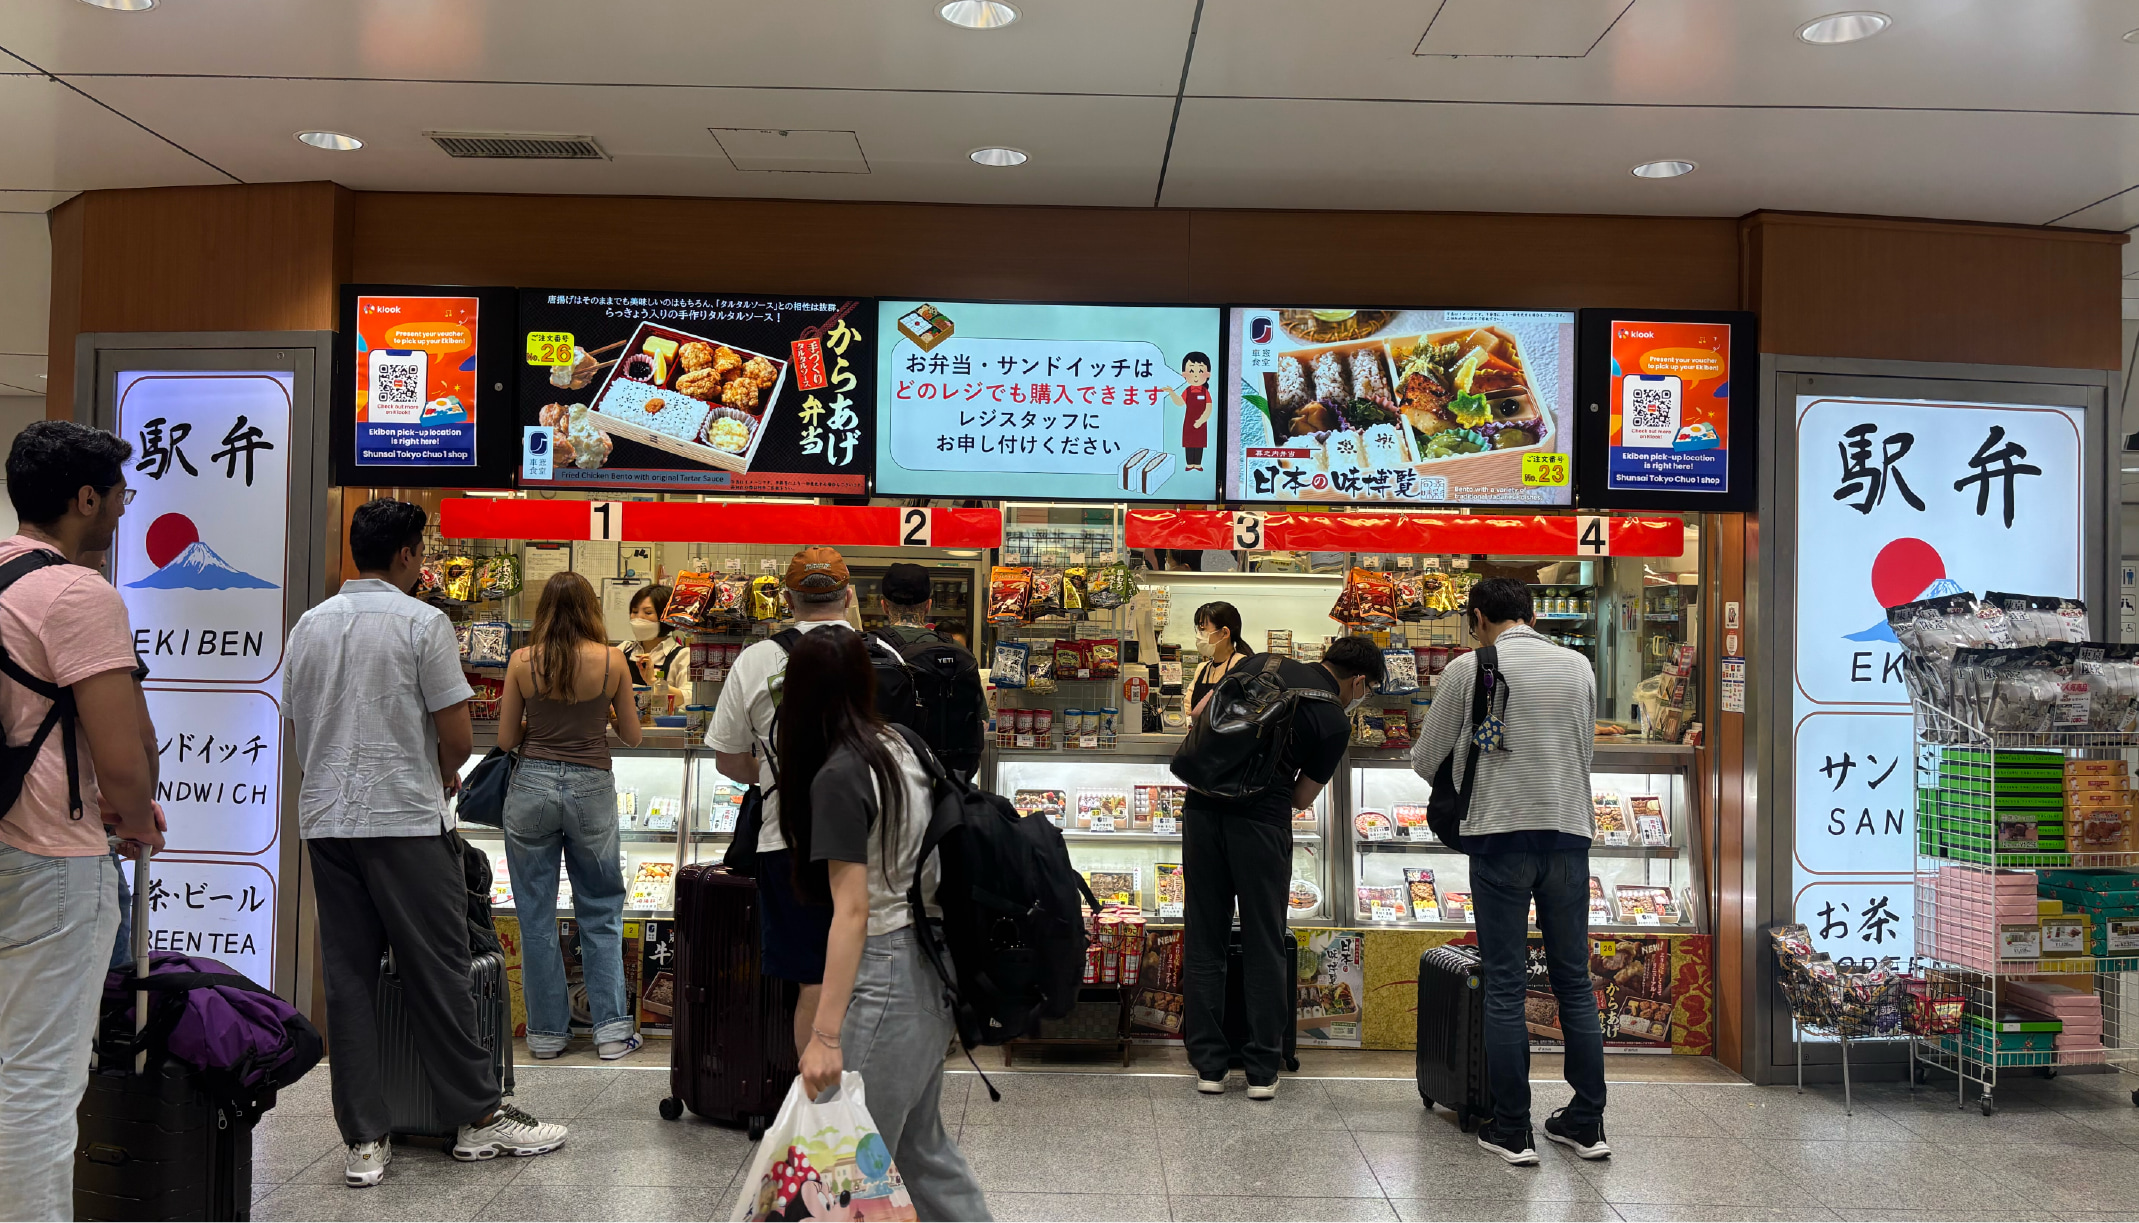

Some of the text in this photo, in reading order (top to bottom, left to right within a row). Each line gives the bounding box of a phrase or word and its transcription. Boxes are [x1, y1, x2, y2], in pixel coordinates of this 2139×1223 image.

[377, 305, 401, 314] klook
[531, 334, 570, 343] ご注文番号
[1630, 330, 1654, 339] klook
[807, 341, 823, 385] 手づくり
[905, 353, 1153, 378] お弁当・サンドイッチは
[1655, 363, 1670, 371] pick
[827, 319, 862, 467] からあげ
[896, 380, 1165, 406] どのレジでも購入できます
[798, 394, 826, 455] 弁当
[959, 410, 1101, 430] レジスタッフに
[369, 428, 462, 438] Ekiben pick-up location
[391, 437, 440, 447] is right here!
[936, 434, 1121, 455] お申し付けください
[135, 415, 275, 487] 駅弁
[363, 450, 396, 459] Shunsai
[397, 450, 422, 460] Tokyo
[422, 450, 443, 459] Chuo
[448, 450, 468, 460] shop
[1527, 455, 1565, 464] ご注文番号
[1622, 452, 1715, 463] Ekiben pick-up location
[561, 471, 580, 479] Fried
[581, 471, 609, 480] Chicken
[611, 472, 633, 480] Bento
[634, 472, 650, 480] with
[652, 473, 679, 483] original
[703, 475, 724, 483] Sauce
[1652, 462, 1673, 471] right
[1673, 462, 1694, 470] here!
[1833, 422, 2042, 529] 駅弁
[1253, 465, 1421, 499] 日本の味博覧
[1616, 473, 1649, 482] Shunsai
[1649, 474, 1674, 485] Tokyo
[1674, 475, 1696, 483] Chuo
[1701, 476, 1720, 486] shop
[593, 503, 611, 539] 1
[903, 509, 927, 546] 2
[1236, 512, 1260, 549] 3
[1579, 518, 1606, 554] 4
[133, 628, 263, 657] EKIBEN
[159, 732, 267, 766] ンドイッチ
[157, 781, 267, 805] NDWICH
[149, 878, 265, 912] 茶・ビール
[208, 933, 256, 955] TEA
[1157, 932, 1180, 946] NEW!
[1641, 940, 1664, 955] NEW!
[1605, 982, 1620, 1038] からあげ
